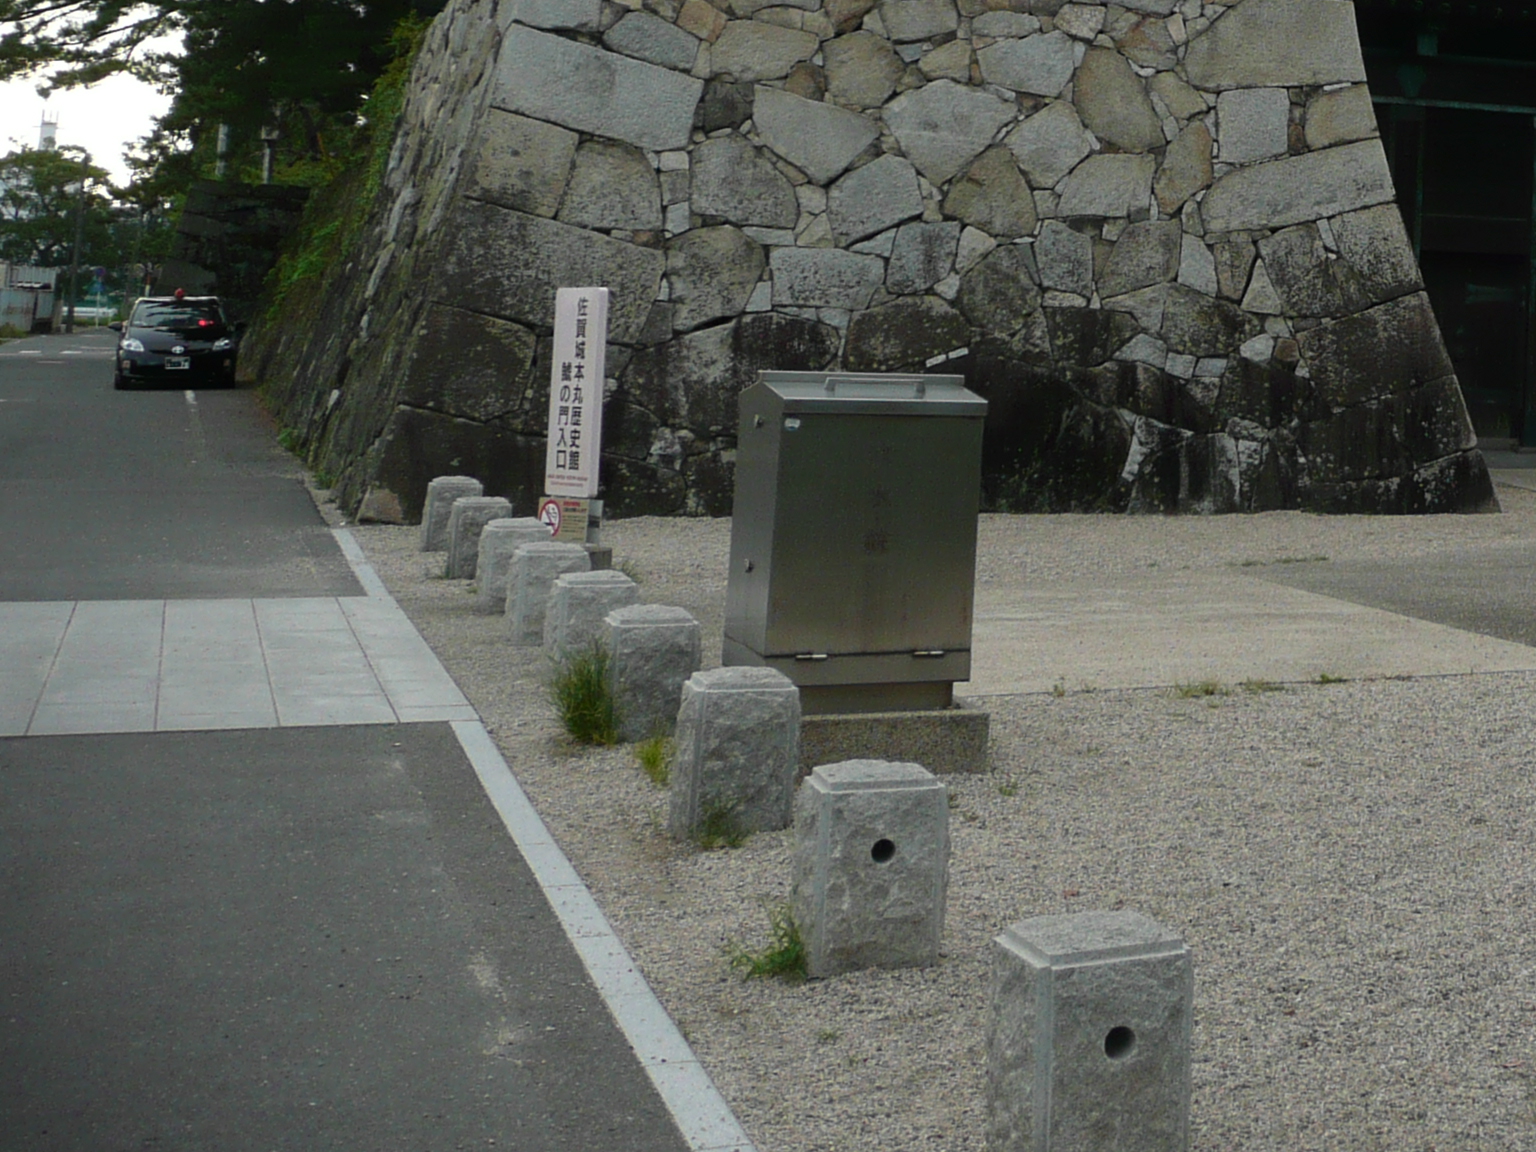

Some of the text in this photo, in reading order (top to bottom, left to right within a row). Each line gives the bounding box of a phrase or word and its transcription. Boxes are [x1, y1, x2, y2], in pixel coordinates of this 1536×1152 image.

[568, 297, 589, 471] 佐賀城本丸歴史館
